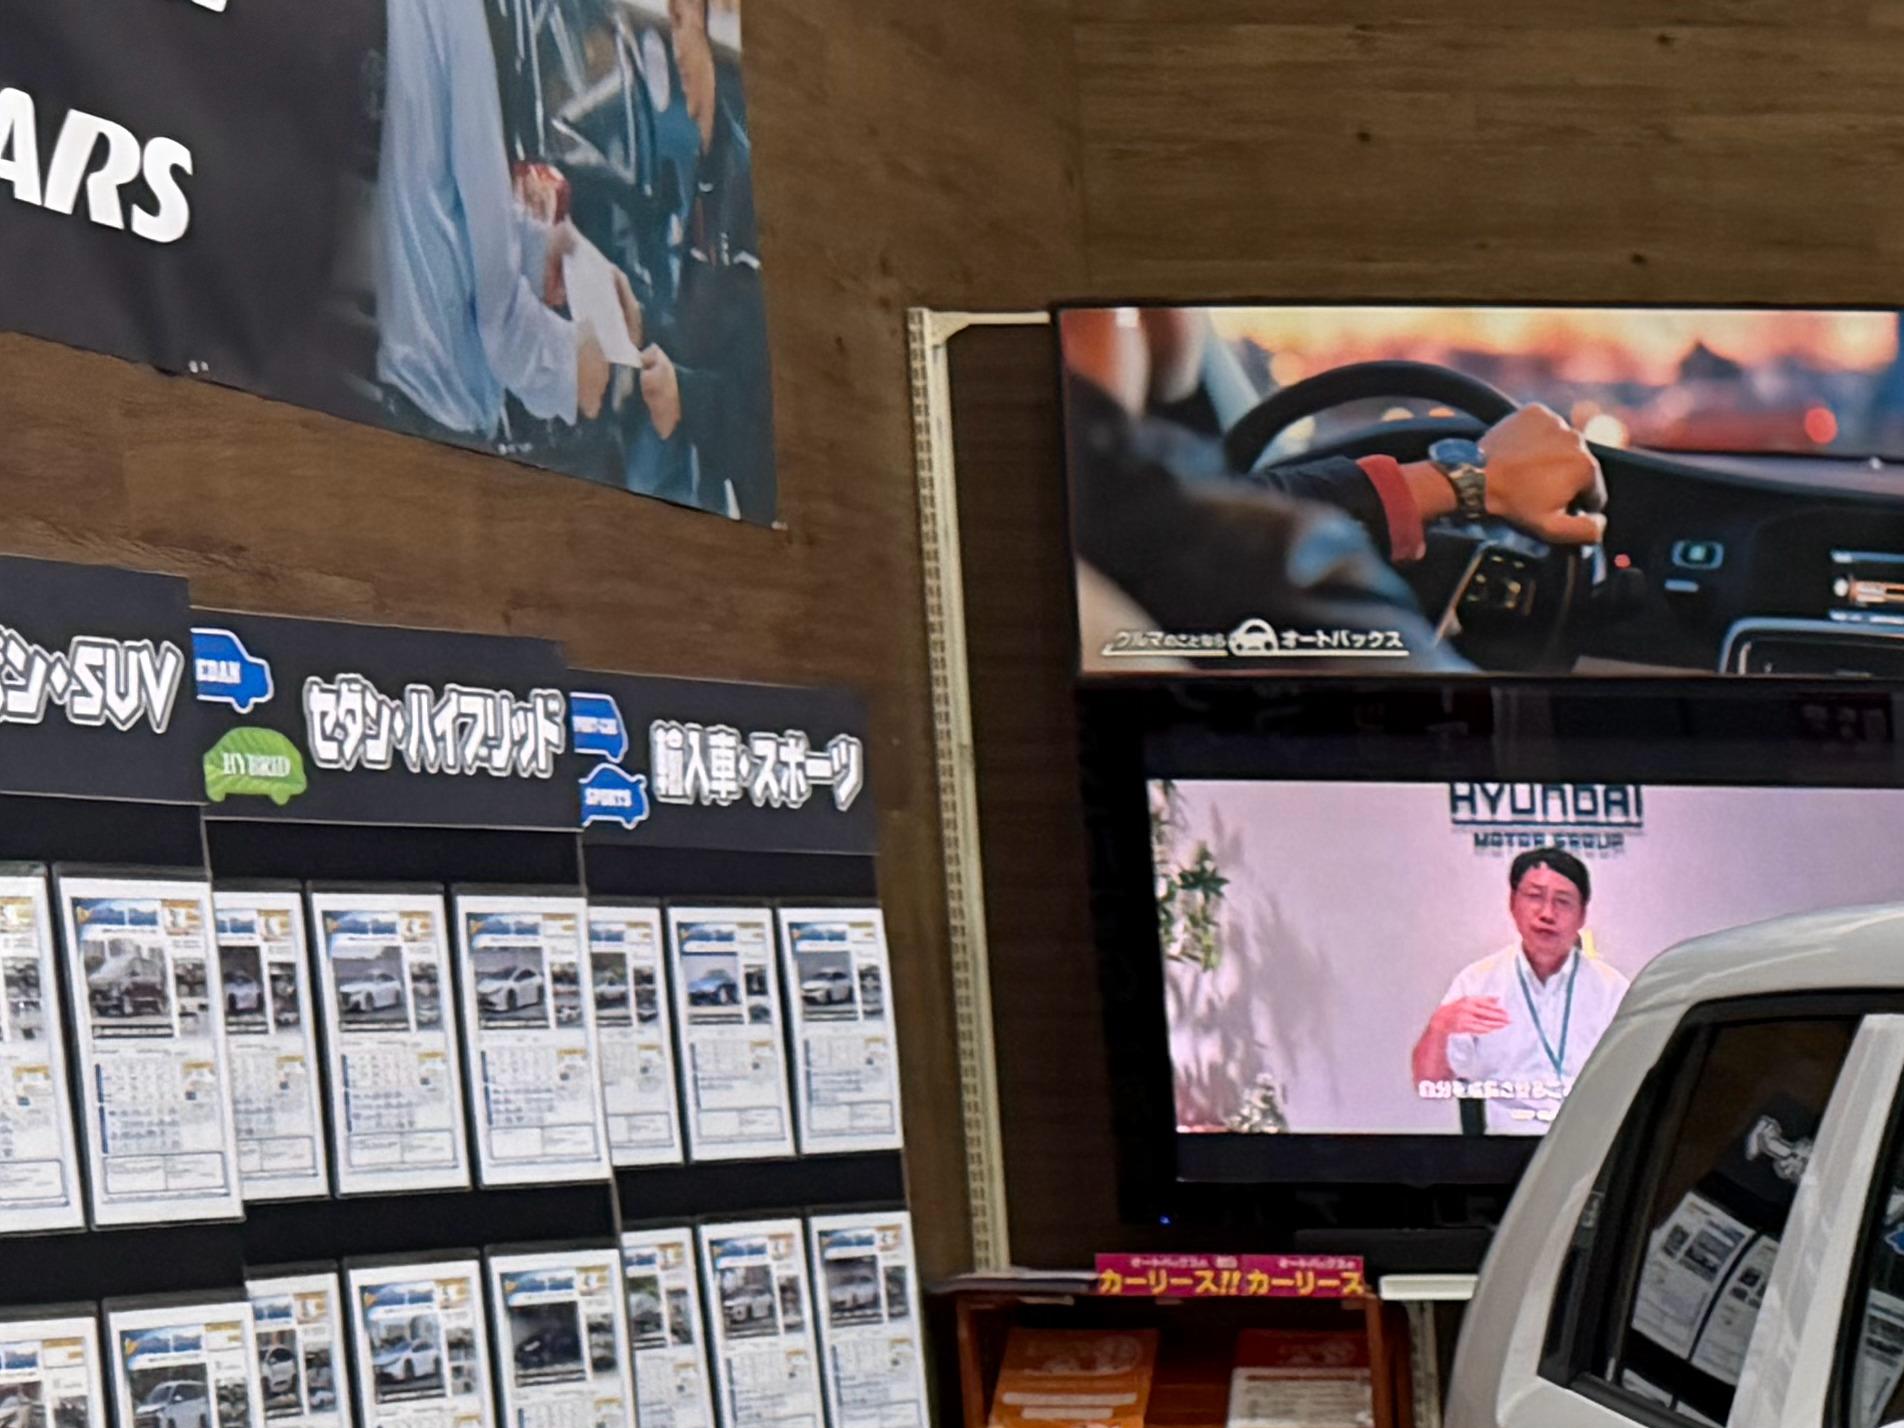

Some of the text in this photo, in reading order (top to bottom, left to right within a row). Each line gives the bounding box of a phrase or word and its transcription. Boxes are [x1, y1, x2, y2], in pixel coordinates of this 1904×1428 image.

[1281, 630, 1403, 648] オートバックス
[0, 627, 185, 734] ン・SUV
[302, 673, 566, 779] セダン・ハイブリッド
[223, 752, 290, 777] HYBRID
[650, 720, 863, 812] 輸入車・スポーツ
[1474, 833, 1547, 848] MOTOR
[1100, 1269, 1241, 1296] カーリース!!
